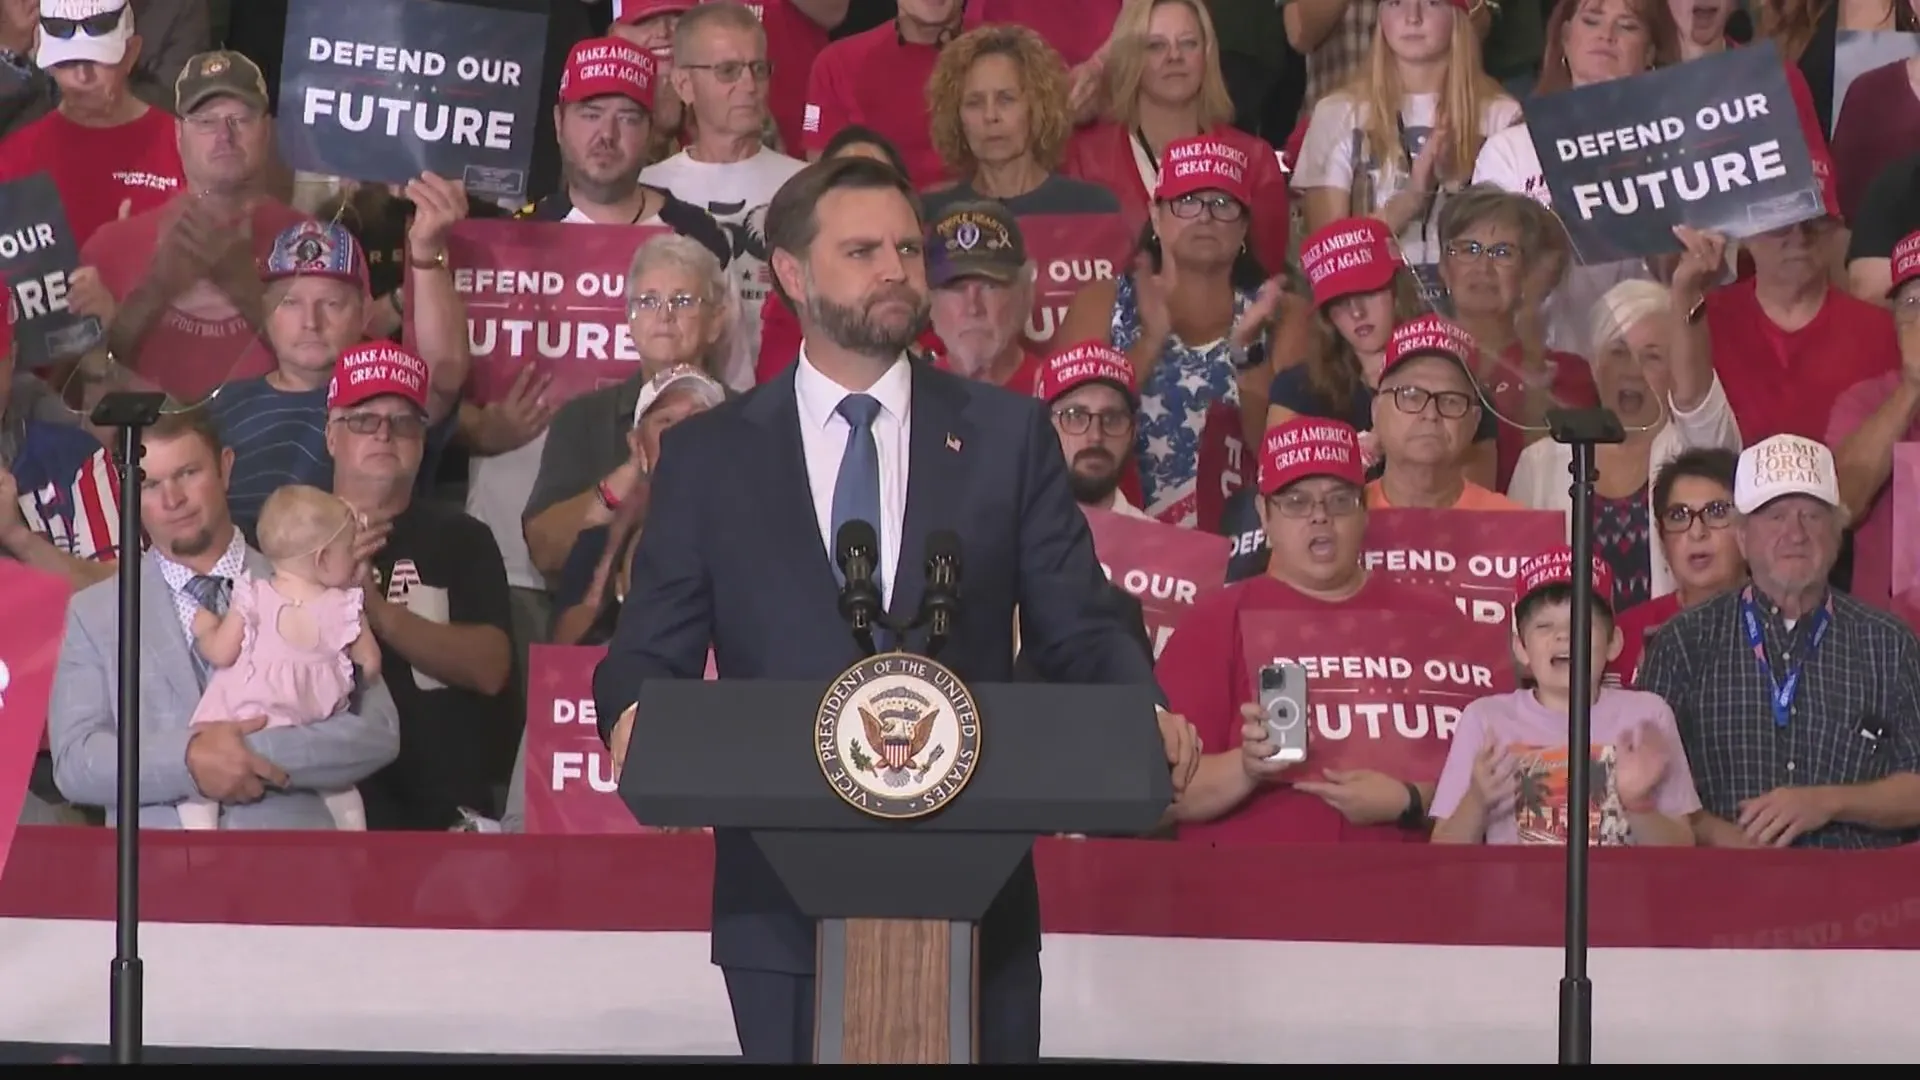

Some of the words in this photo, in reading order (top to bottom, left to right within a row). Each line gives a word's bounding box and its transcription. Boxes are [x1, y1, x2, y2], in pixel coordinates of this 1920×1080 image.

[308, 37, 446, 76] DEFEND
[457, 56, 522, 87] OUR
[576, 46, 607, 64] MAKE
[608, 45, 654, 75] AMERICA
[580, 63, 618, 80] GREAT
[617, 65, 649, 88] AGAIN
[303, 87, 515, 150] FUTURE
[1556, 117, 1685, 162] DEFEND
[1696, 93, 1770, 131] OUR
[1169, 143, 1202, 162] MAKE
[1203, 142, 1248, 168] AMERICA
[1175, 159, 1212, 178] GREAT
[1572, 139, 1787, 220] FUTURE
[1320, 228, 1375, 256] AMERICA
[1049, 258, 1113, 282] OUR
[1337, 248, 1374, 271] AGAIN
[454, 268, 564, 295] EFEND
[576, 272, 625, 298] OU
[467, 319, 641, 360] UTURE
[1392, 320, 1426, 343] MAKE
[1397, 335, 1435, 355] GREAT
[343, 349, 377, 370] MAKE
[379, 347, 426, 378] AMERICA
[1051, 347, 1084, 370] MAKE
[350, 365, 388, 385] GREAT
[1057, 362, 1096, 383] GREAT
[1267, 429, 1299, 454] MAKE
[1301, 426, 1353, 447] AMERICA
[1753, 441, 1820, 460] TRUMP
[1275, 446, 1312, 471] GREAT
[1313, 445, 1350, 463] AGAIN
[1754, 455, 1820, 475] FORCE
[1754, 470, 1821, 488] CAPTAIN
[1357, 550, 1456, 572] FEND
[1521, 554, 1551, 577] MAKE
[1124, 569, 1197, 605] OUR
[874, 660, 892, 674] OF
[900, 660, 927, 676] THE
[1273, 656, 1412, 679] EFEND
[1424, 659, 1493, 688] OUR
[820, 667, 865, 762] PRESIDENT
[934, 671, 976, 737] UNITED
[1307, 703, 1464, 740] UTUR
[832, 768, 868, 807] VICE
[923, 750, 973, 808] STATES
